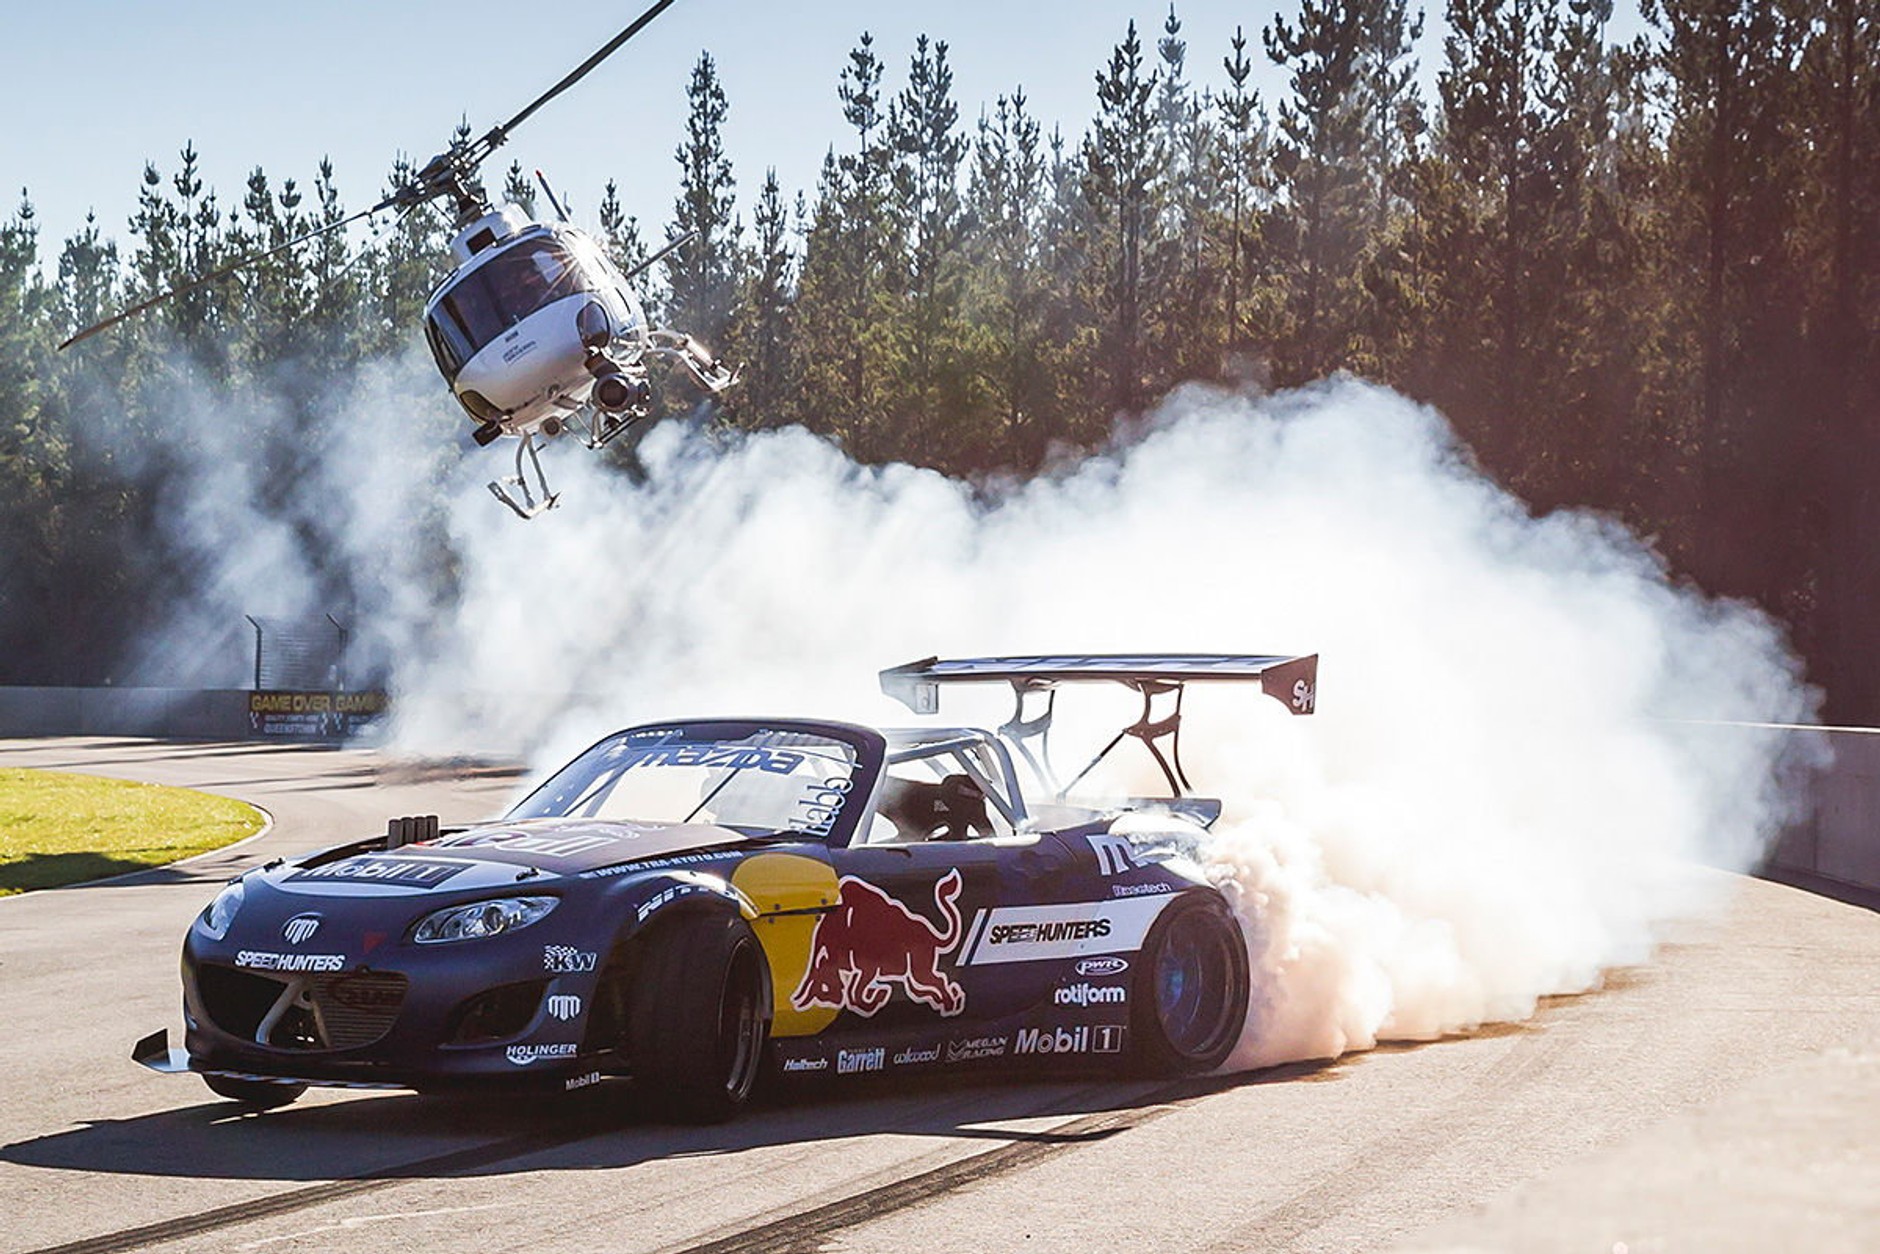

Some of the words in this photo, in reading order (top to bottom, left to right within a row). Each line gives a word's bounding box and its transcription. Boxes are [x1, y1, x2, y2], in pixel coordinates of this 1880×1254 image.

[252, 693, 291, 711] GAME
[293, 693, 330, 712] OVER
[302, 862, 416, 879] Mobil
[552, 953, 598, 972] KW
[1055, 983, 1126, 1007] rotiform
[1014, 1025, 1088, 1055] Mobil
[506, 1044, 577, 1056] HOLINGER
[837, 1047, 886, 1073] Garrett
[565, 1074, 590, 1090] Mobil
